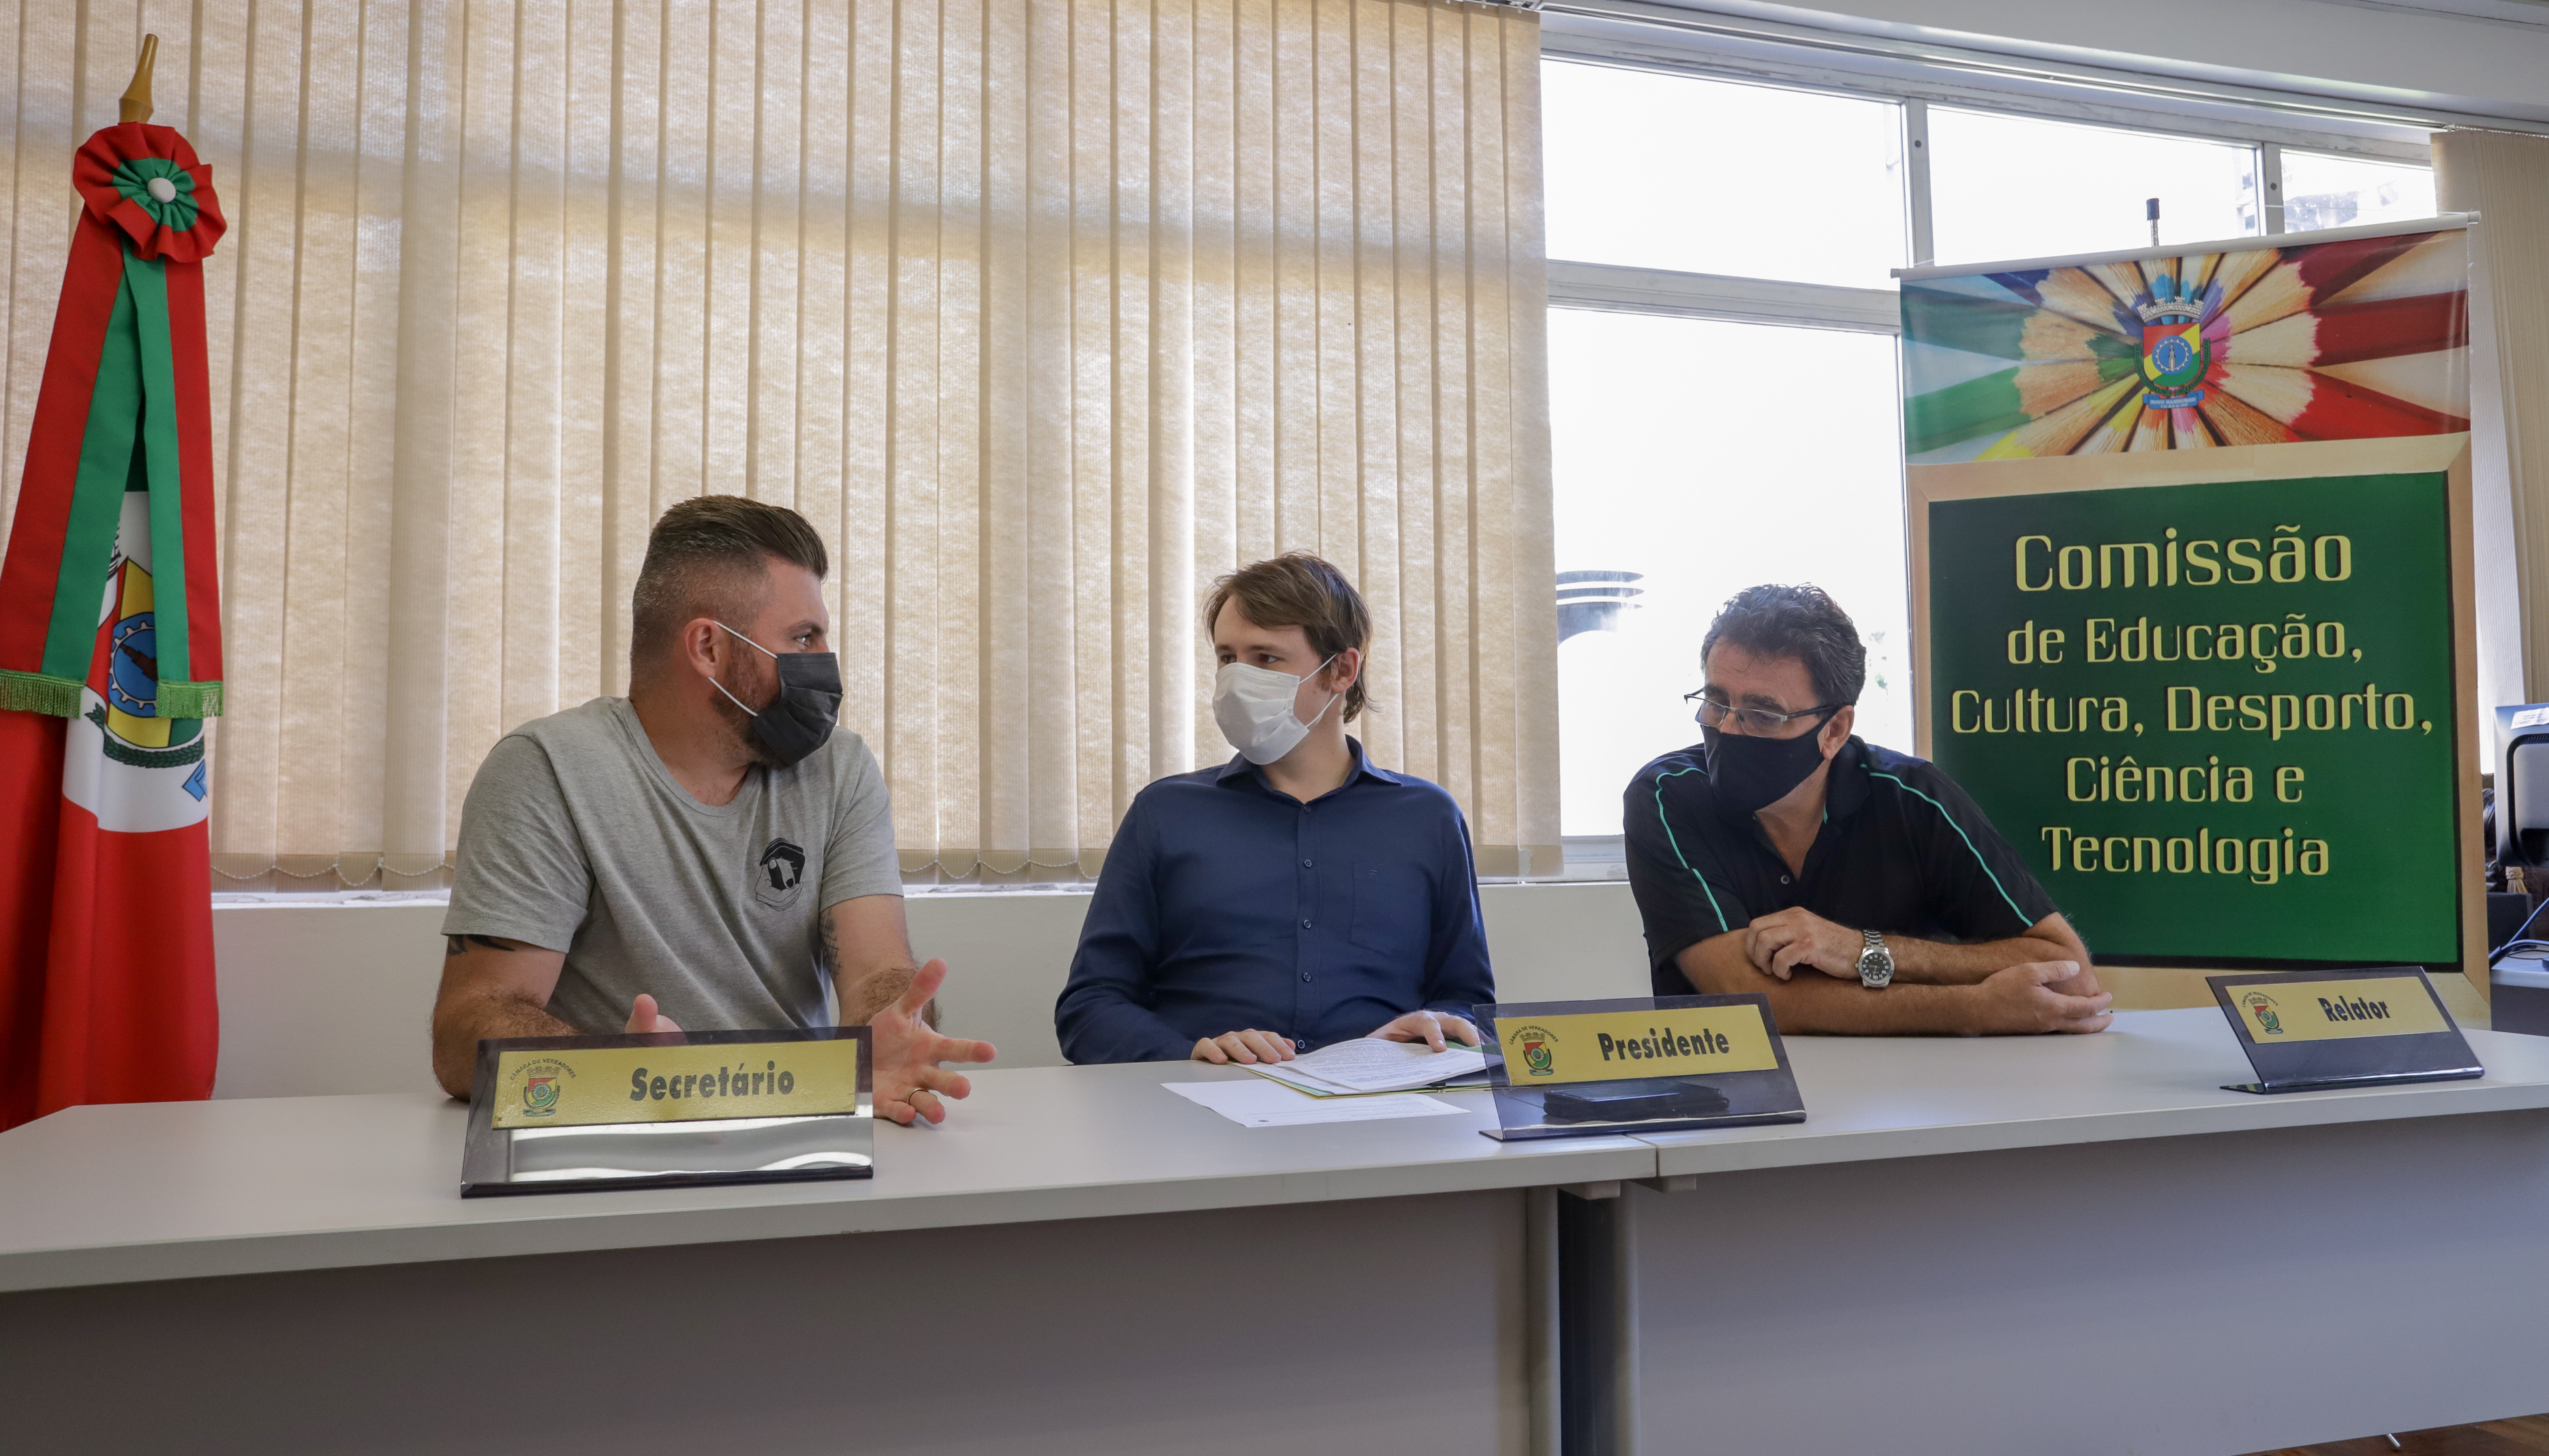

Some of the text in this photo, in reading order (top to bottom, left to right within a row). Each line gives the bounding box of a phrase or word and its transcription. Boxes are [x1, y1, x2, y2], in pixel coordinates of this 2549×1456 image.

[2015, 525, 2351, 592] Comissão
[2007, 613, 2362, 674] de Educação,
[1953, 683, 2432, 741] Cultura, Desporto,
[2066, 756, 2304, 803] Ciência e
[2042, 826, 2330, 884] Tecnologia
[2253, 991, 2278, 1006] VEREADORES
[2317, 995, 2390, 1021] Relator
[1509, 1029, 1522, 1045] CÂMARA
[1528, 1025, 1559, 1042] VEREADORES
[1597, 1027, 1730, 1061] Presidente
[510, 1062, 532, 1081] CÂMARA
[543, 1058, 577, 1079] VEREADORES
[629, 1060, 795, 1102] Secretário
